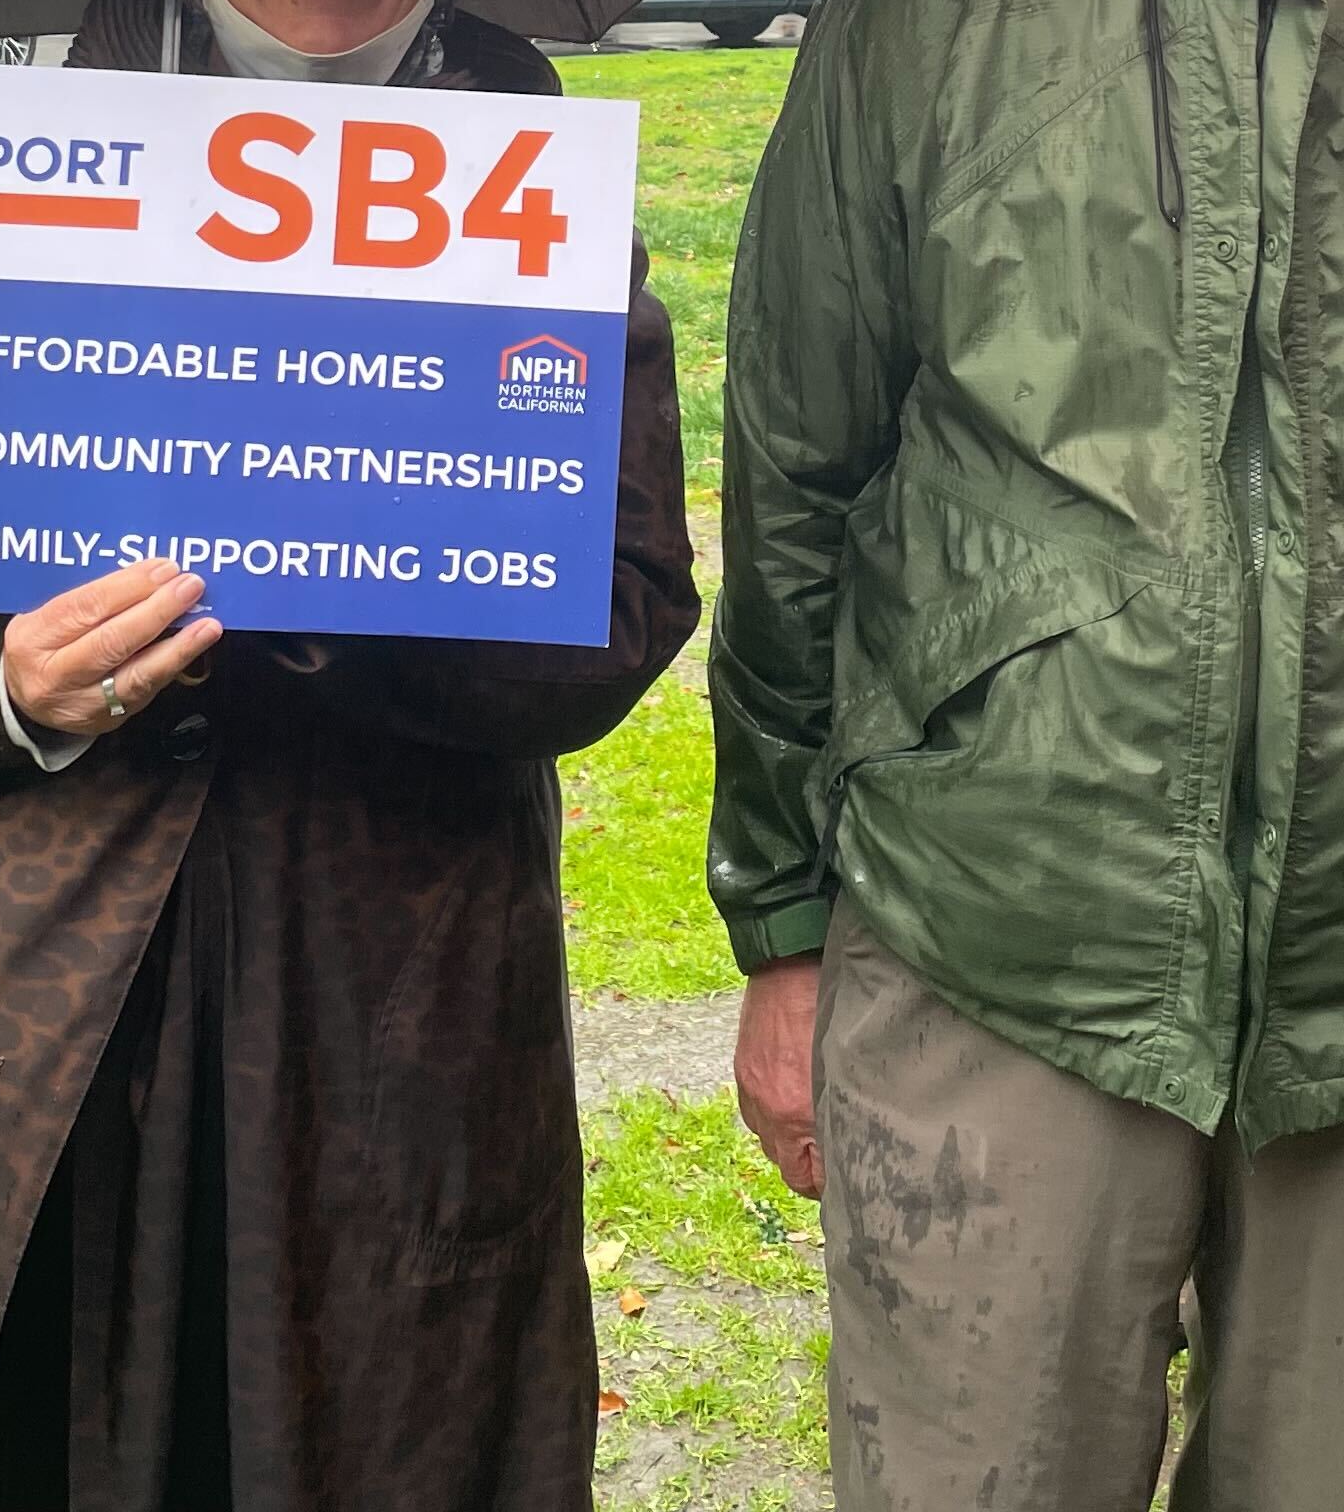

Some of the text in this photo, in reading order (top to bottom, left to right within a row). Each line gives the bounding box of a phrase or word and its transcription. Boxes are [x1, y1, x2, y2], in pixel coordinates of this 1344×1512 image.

[195, 111, 568, 278] SB4
[277, 348, 445, 391] HOMES
[511, 356, 576, 385] NPH
[498, 383, 586, 400] NORTHERN
[498, 397, 585, 414] CALIFORNIA
[242, 442, 584, 494] PARTNERSHIPS
[438, 548, 557, 589] JOBS
